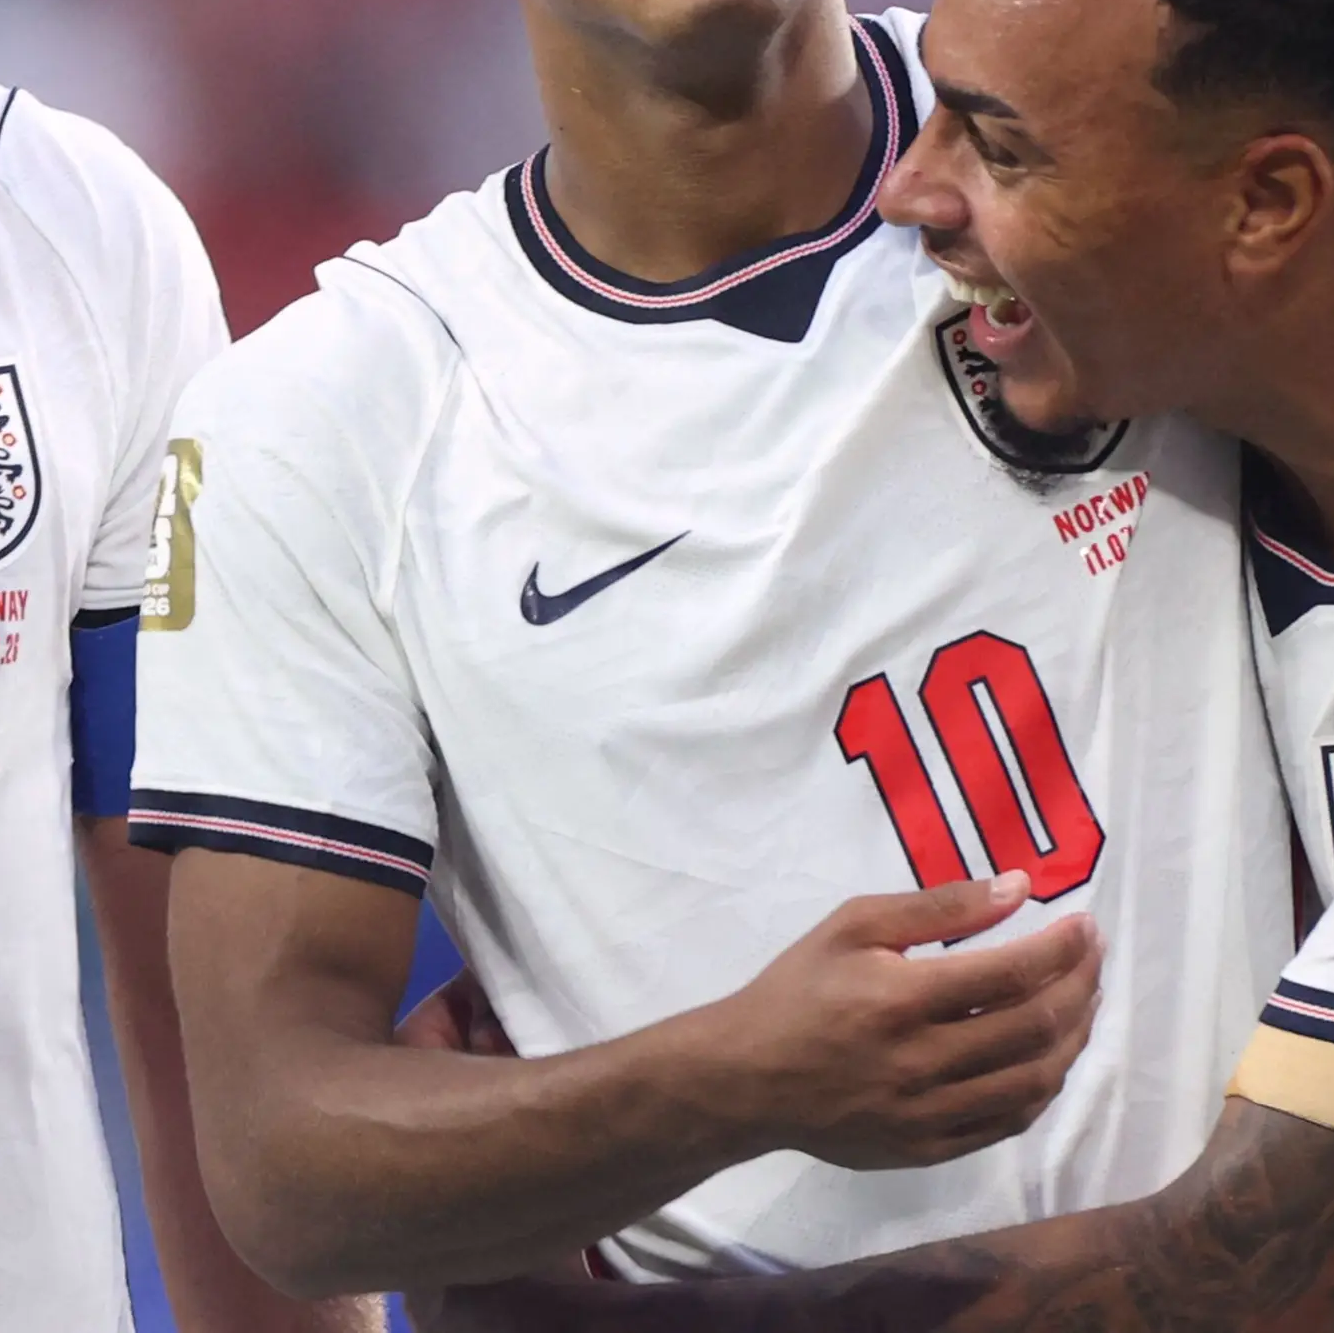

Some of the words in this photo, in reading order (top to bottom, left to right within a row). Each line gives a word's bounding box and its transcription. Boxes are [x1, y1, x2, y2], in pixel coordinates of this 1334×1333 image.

[1053, 471, 1150, 544] NORWA
[1085, 525, 1134, 575] 11.07
[140, 597, 170, 616] 26
[833, 629, 1106, 948] 10
